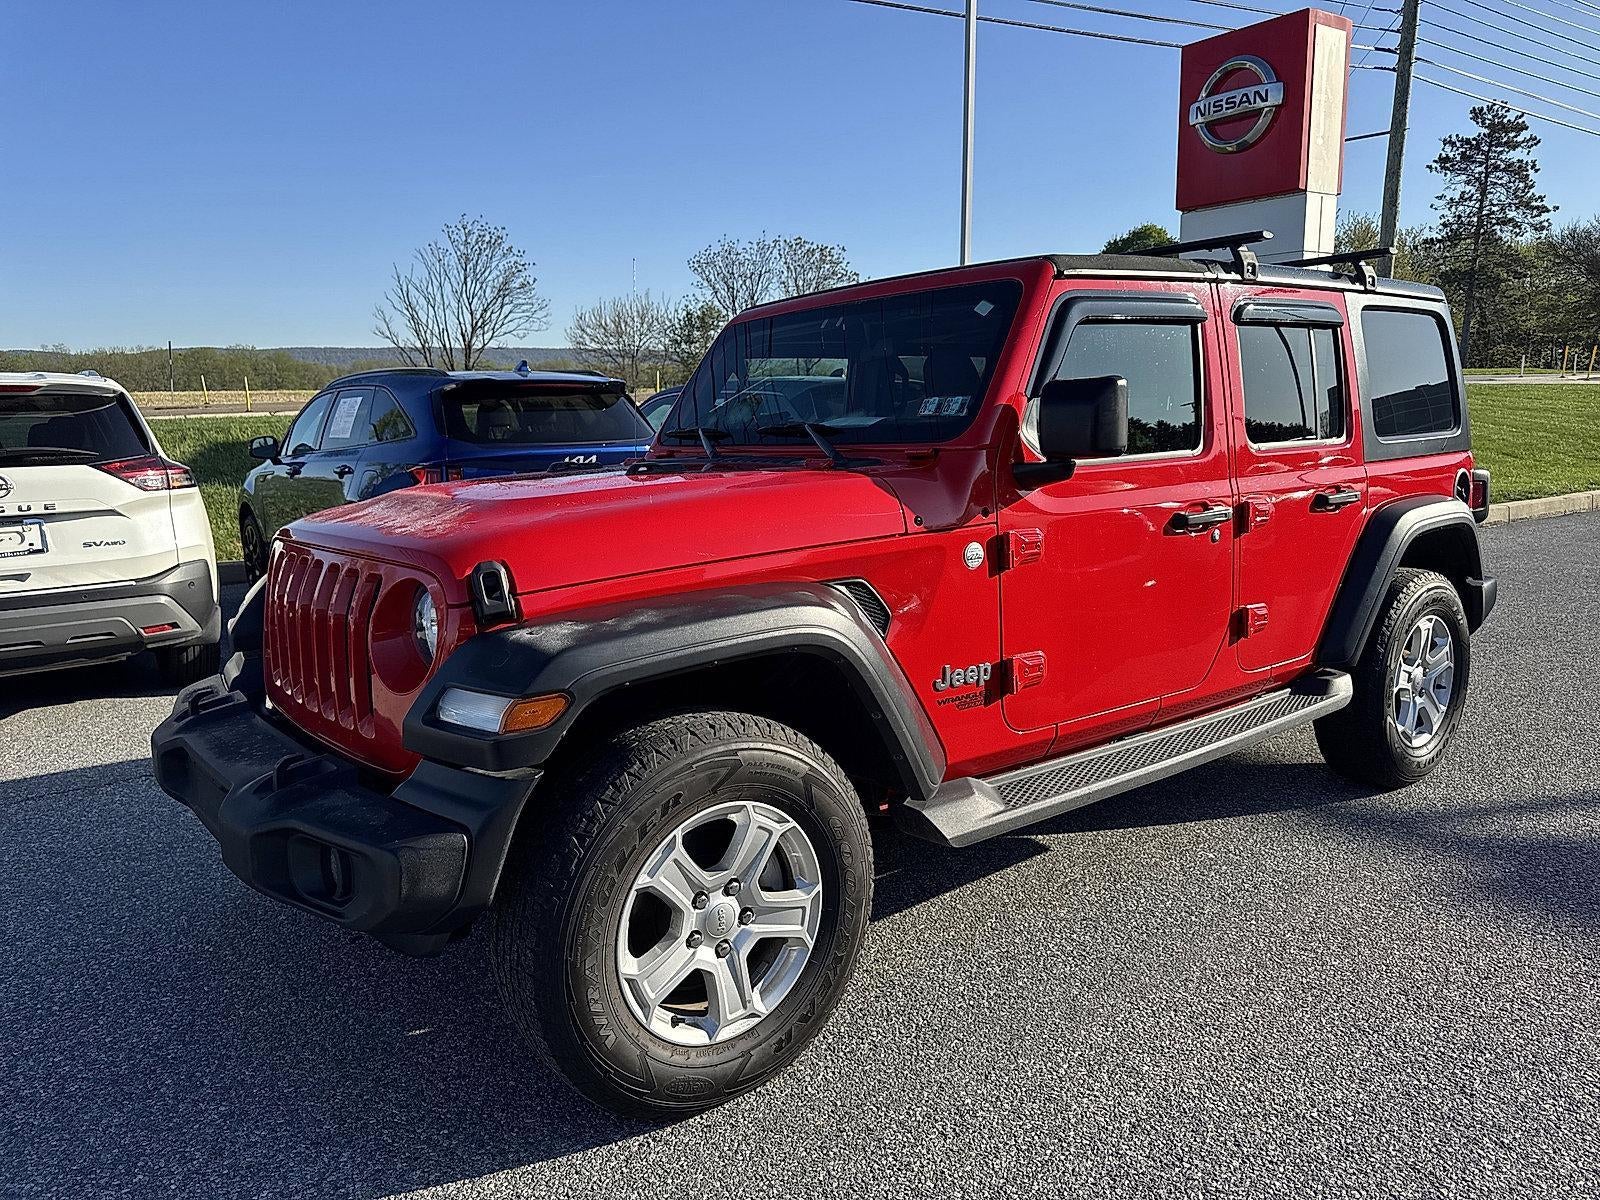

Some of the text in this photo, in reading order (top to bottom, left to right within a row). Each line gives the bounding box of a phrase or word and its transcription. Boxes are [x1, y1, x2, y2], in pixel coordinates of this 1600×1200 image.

[1195, 88, 1269, 120] NISSAN
[932, 661, 992, 692] Jeep
[585, 790, 683, 1051] WRANGLER
[771, 816, 858, 1055] GOODYEAR
